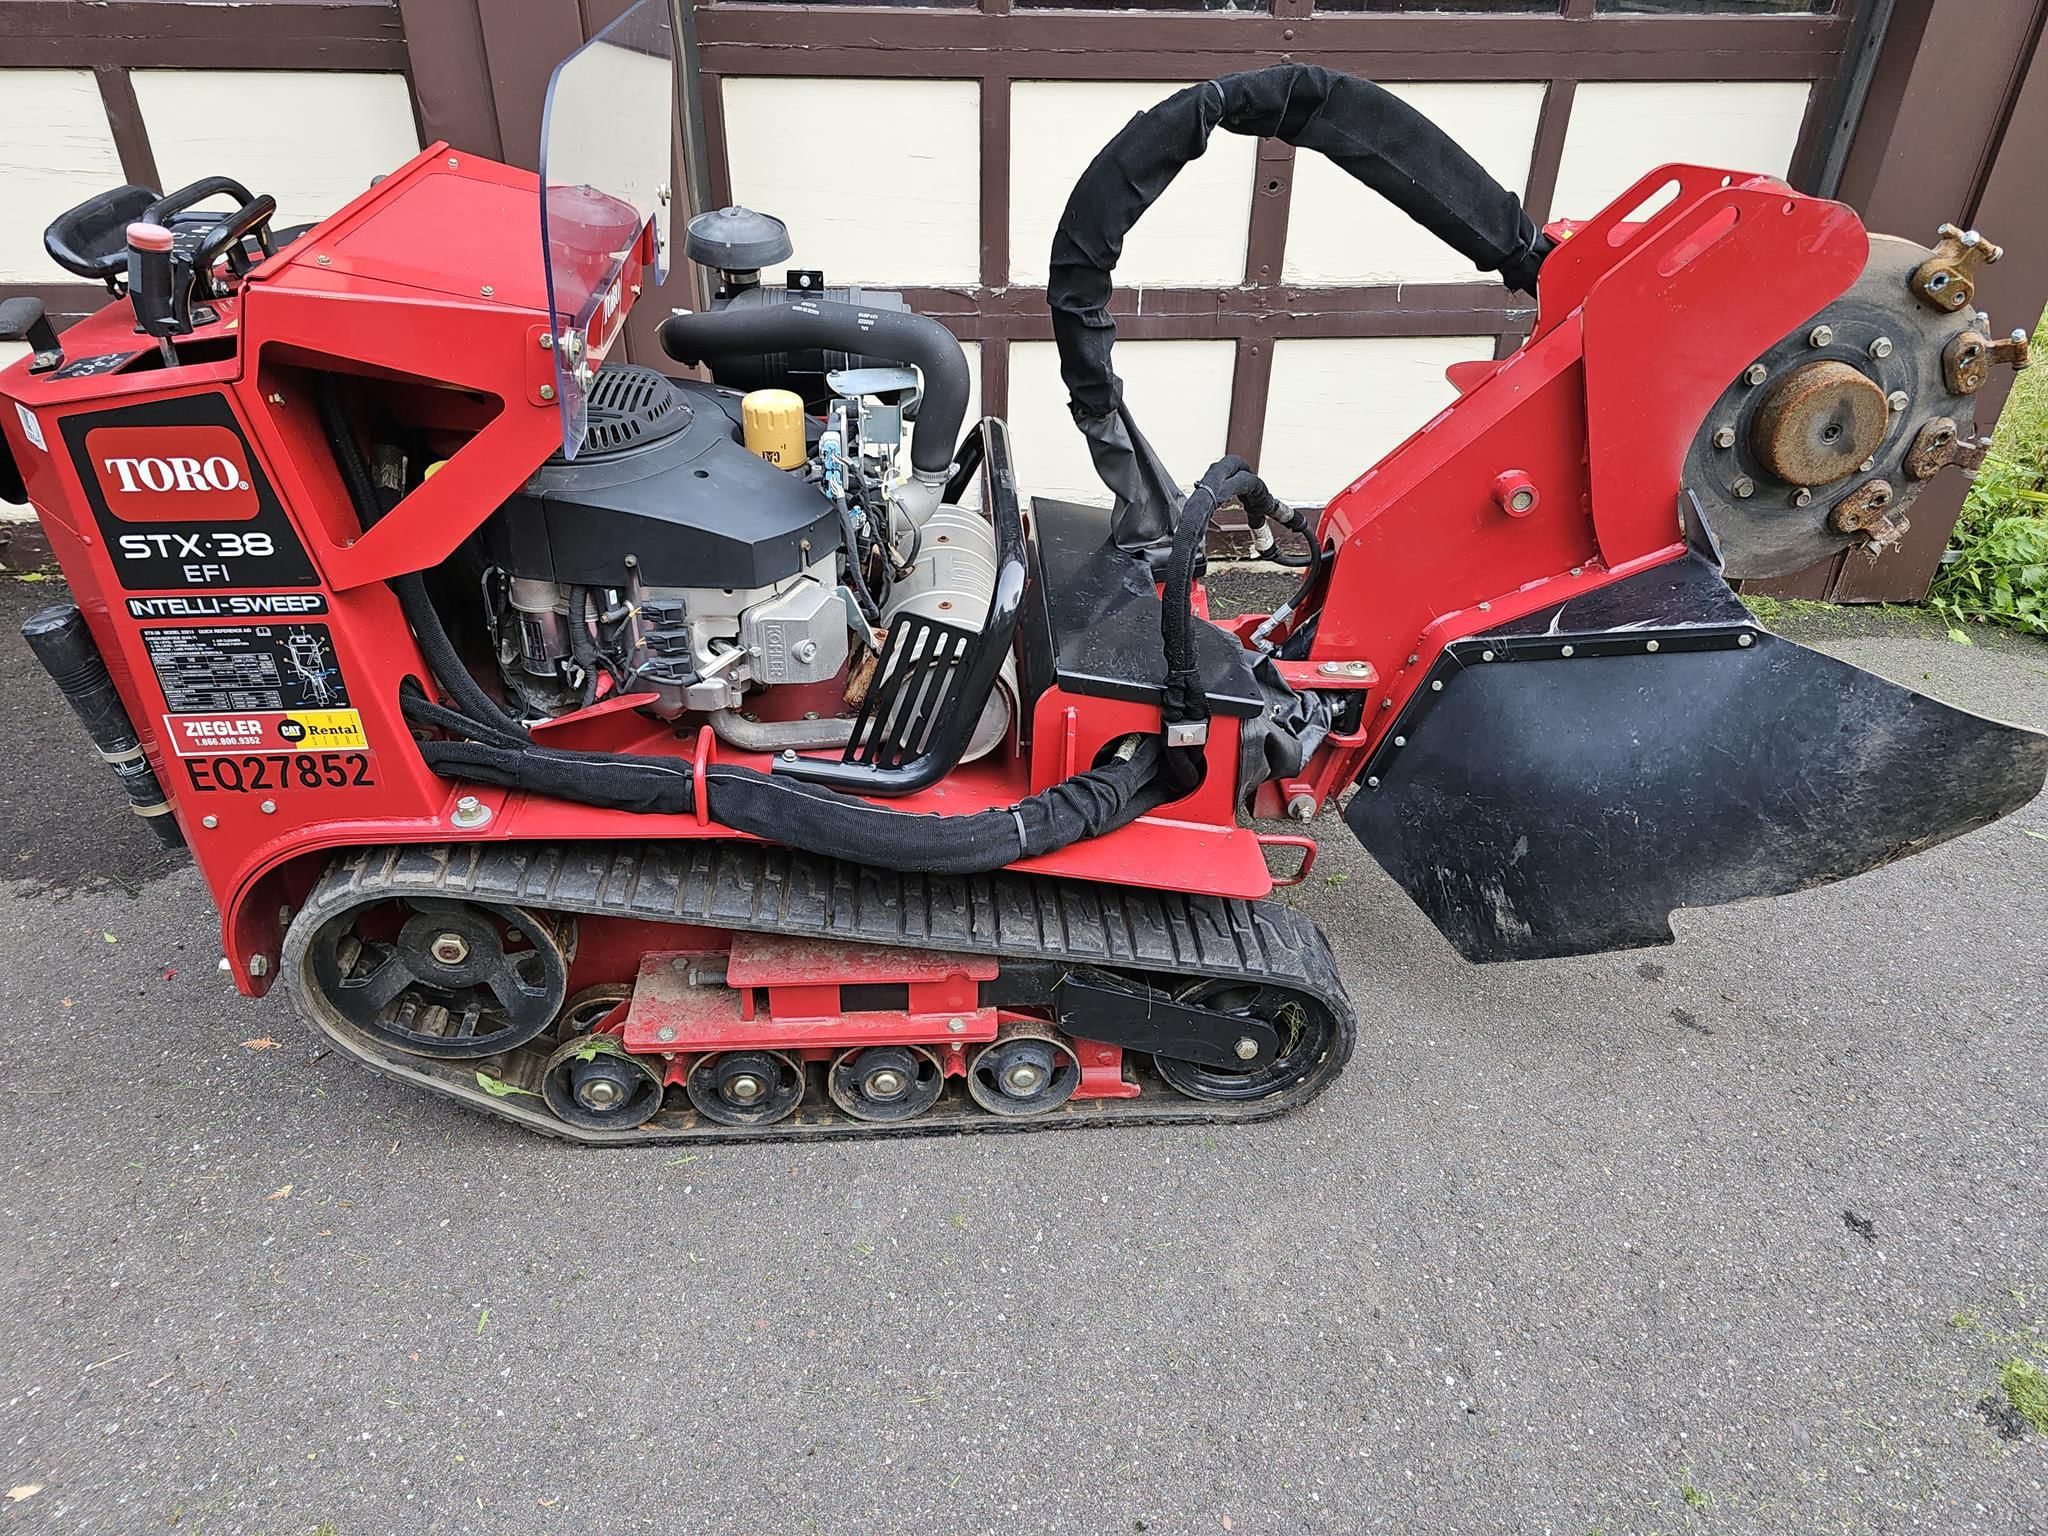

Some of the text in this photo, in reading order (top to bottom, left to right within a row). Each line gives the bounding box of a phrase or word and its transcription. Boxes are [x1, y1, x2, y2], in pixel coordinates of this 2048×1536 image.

[104, 456, 240, 492] TORO
[183, 564, 231, 583] EFI
[129, 595, 321, 616] INTELLI-SWEEP
[767, 625, 784, 678] KOHLER
[183, 719, 263, 737] ZIEGLER
[280, 725, 301, 737] CAT
[307, 724, 358, 735] Rental
[194, 737, 261, 746] 1.866.800.9352
[184, 753, 375, 793] EQ27852
